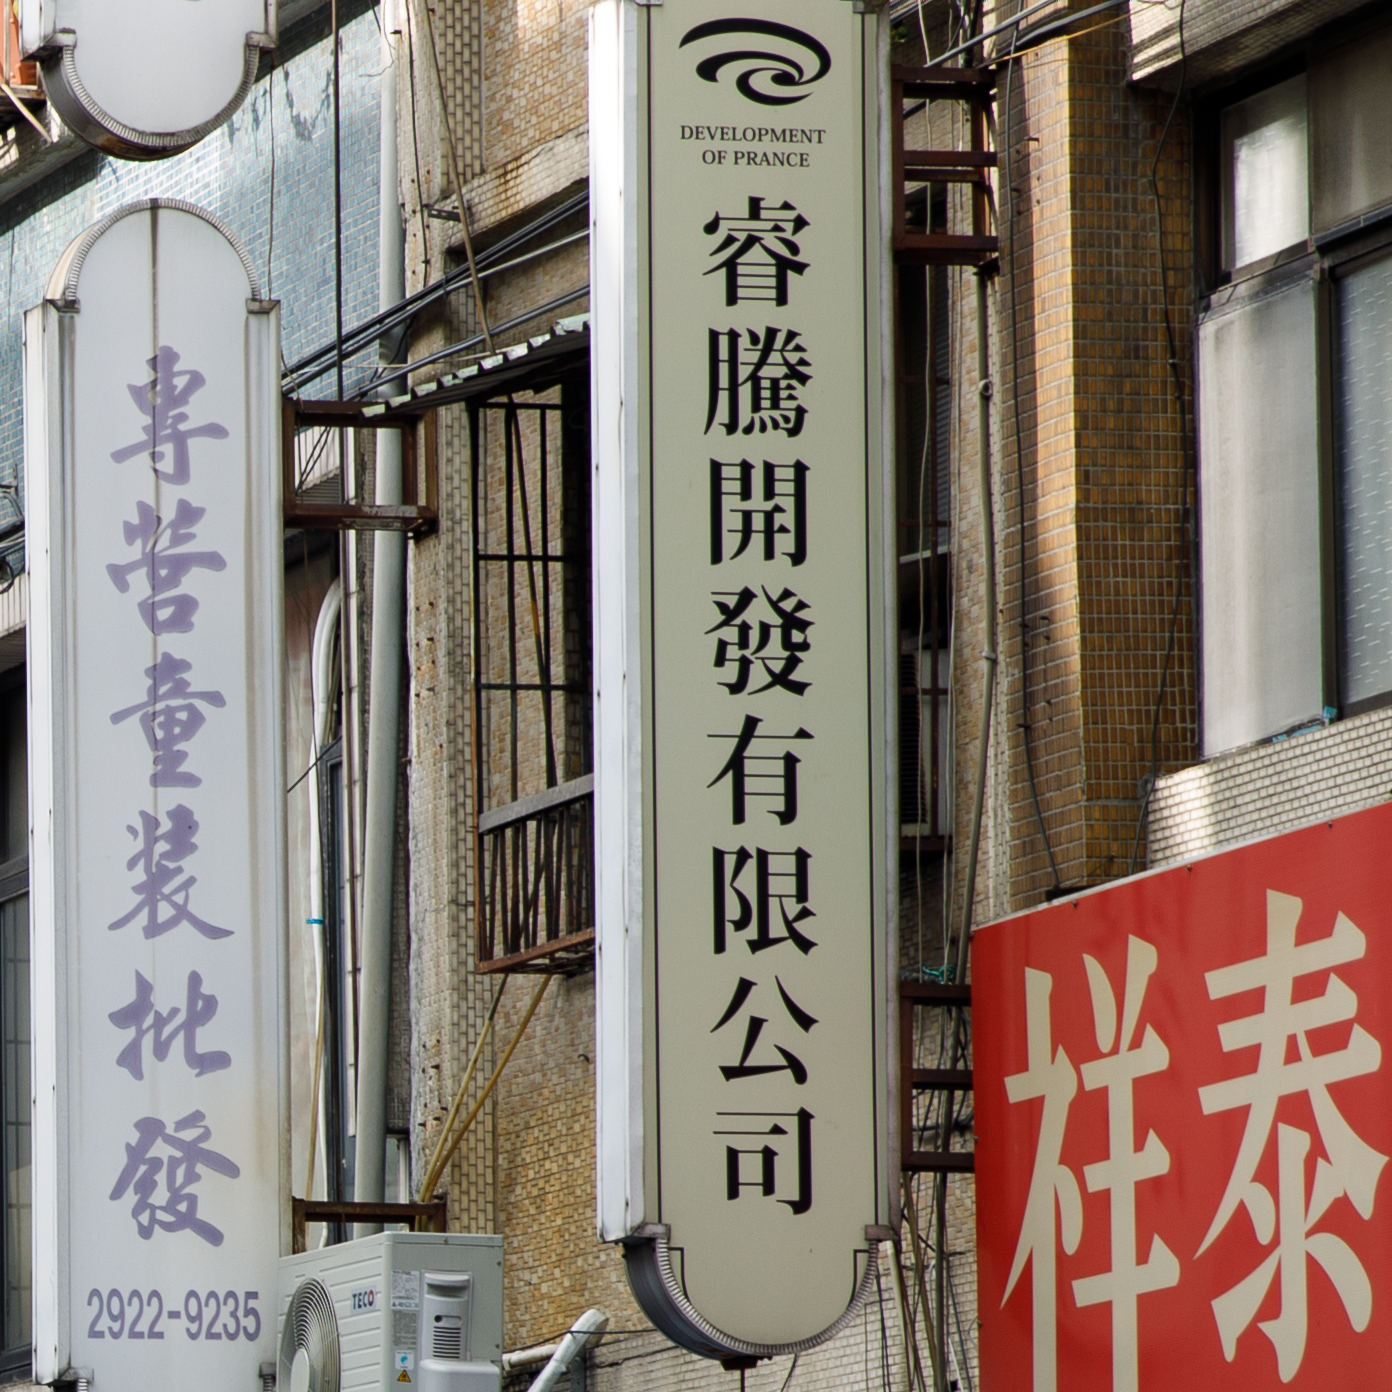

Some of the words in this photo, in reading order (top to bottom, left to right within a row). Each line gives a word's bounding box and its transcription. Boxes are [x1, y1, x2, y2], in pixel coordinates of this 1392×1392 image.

[680, 125, 826, 144] DEVELOPMENT
[702, 150, 727, 165] OF
[733, 150, 810, 167] PRANCE
[701, 196, 818, 1214] 睿騰開發有限公司
[106, 345, 243, 1248] 專營童裝批發
[86, 1287, 261, 1342] 2922-9235
[352, 1289, 375, 1310] TECO
